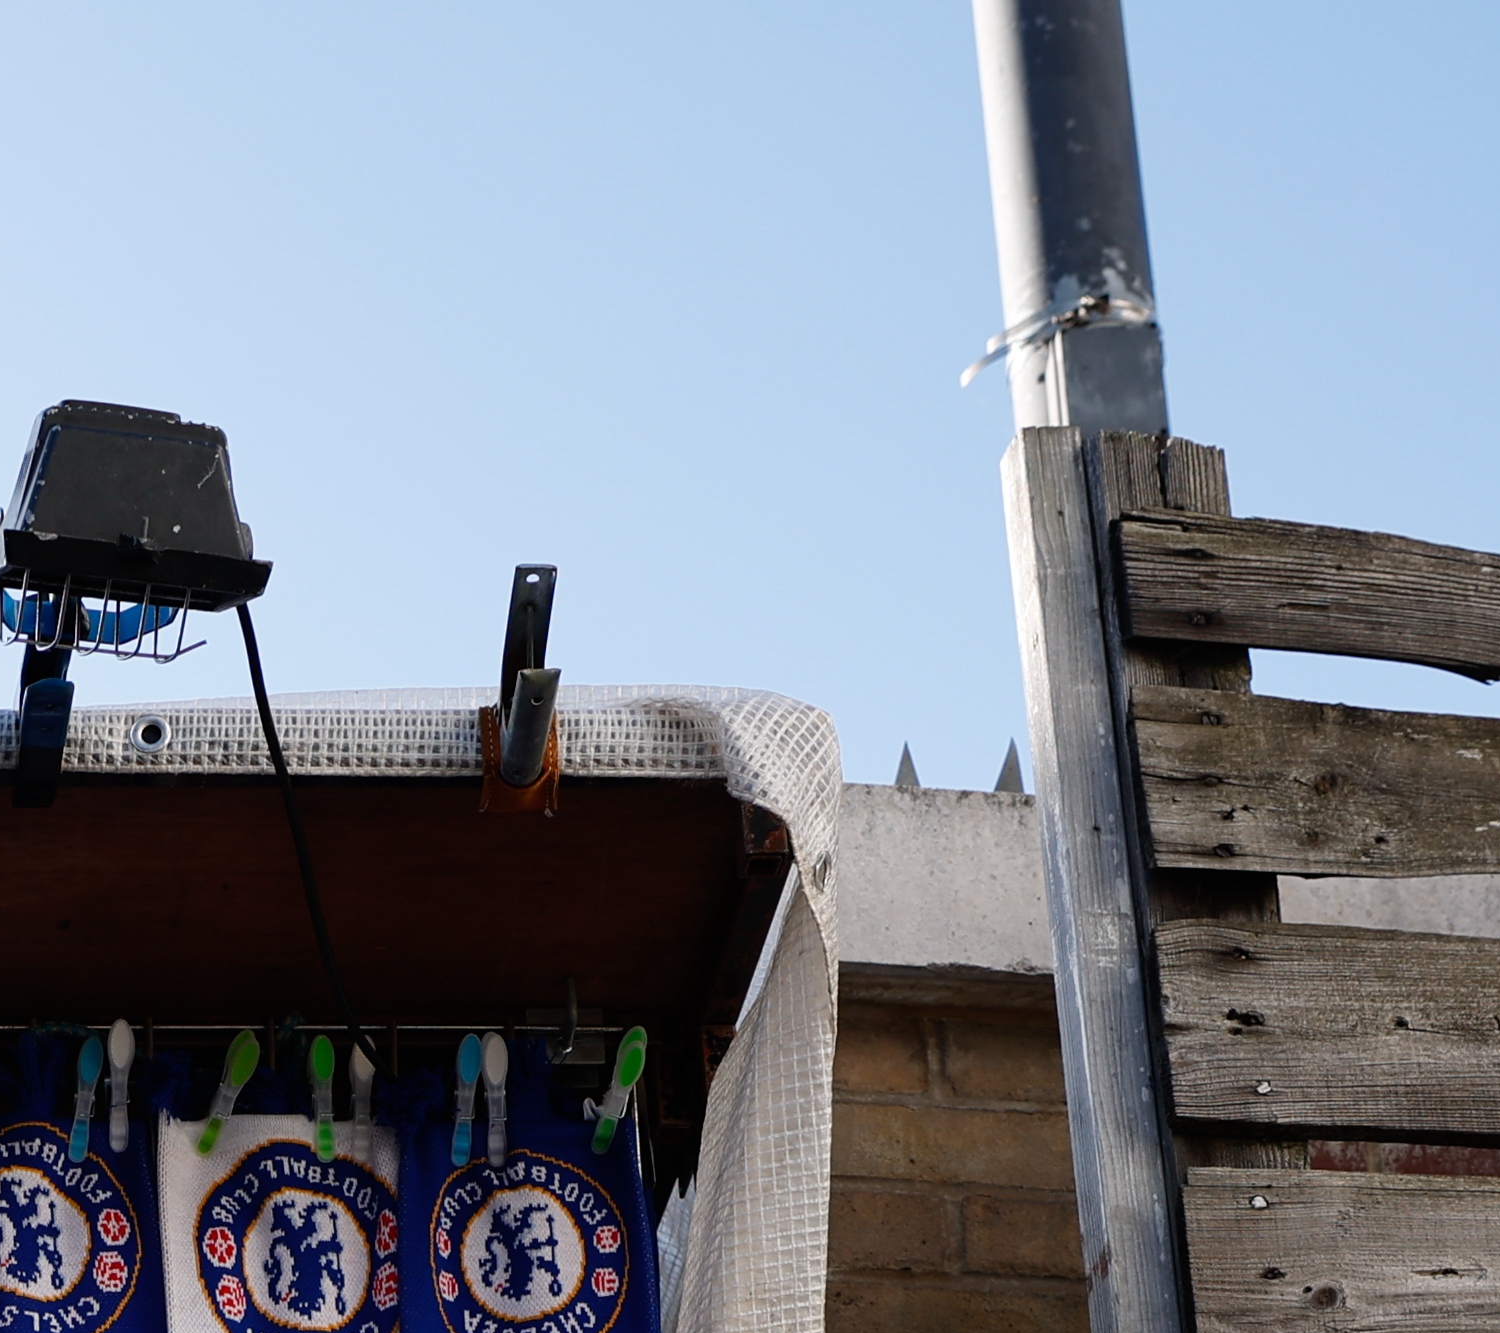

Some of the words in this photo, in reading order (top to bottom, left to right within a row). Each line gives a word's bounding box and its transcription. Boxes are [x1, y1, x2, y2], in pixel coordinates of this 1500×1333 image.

[212, 1173, 259, 1225] CLUB
[258, 1156, 379, 1220] FOOTBALL
[482, 1161, 608, 1225] FOOTBALL
